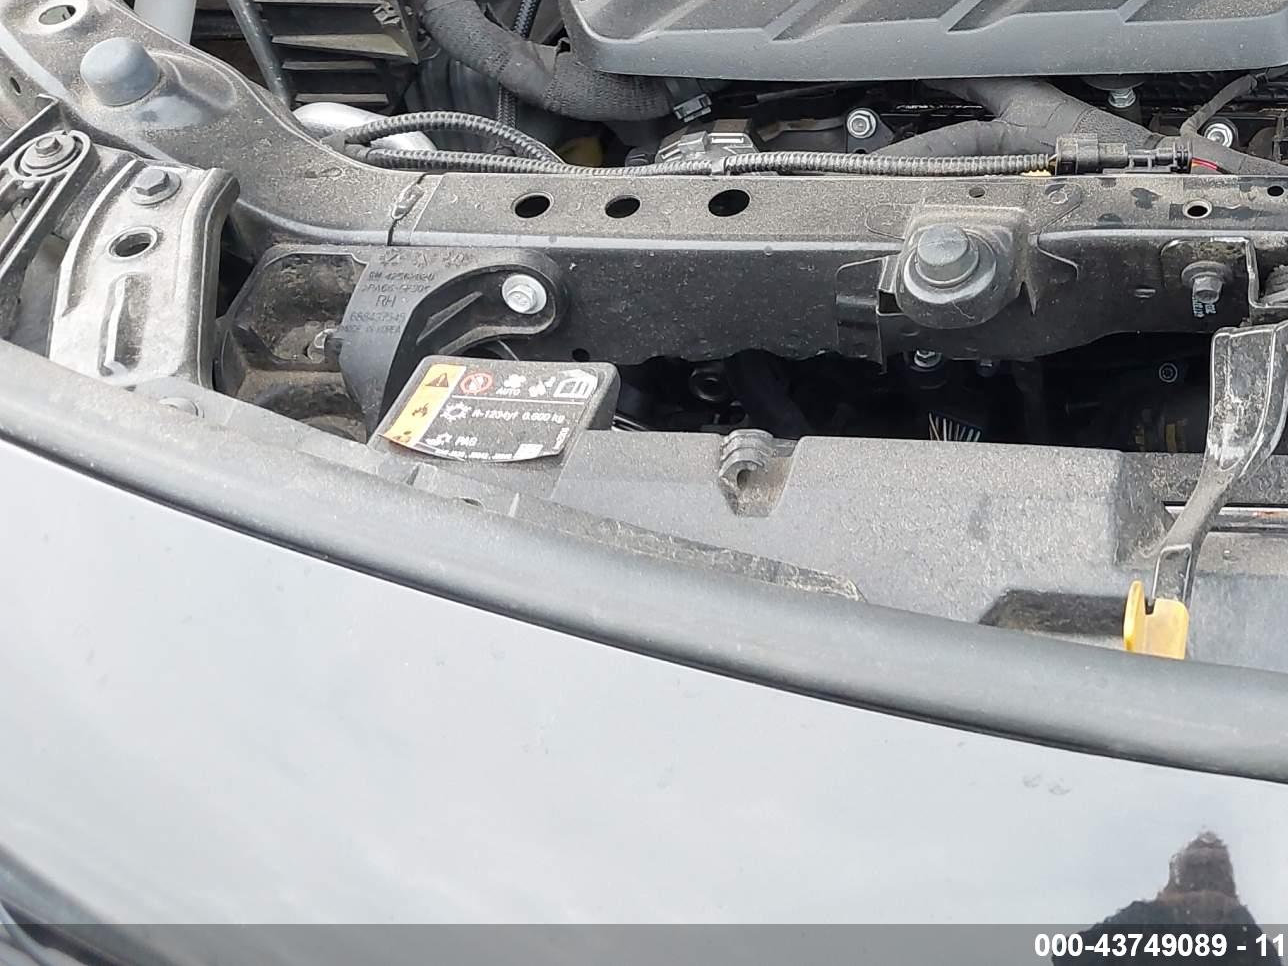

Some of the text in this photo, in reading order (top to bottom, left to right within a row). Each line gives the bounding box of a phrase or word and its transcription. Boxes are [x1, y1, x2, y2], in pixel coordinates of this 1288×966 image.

[376, 294, 397, 307] RH
[496, 387, 521, 396] AUTO
[552, 413, 566, 424] kg
